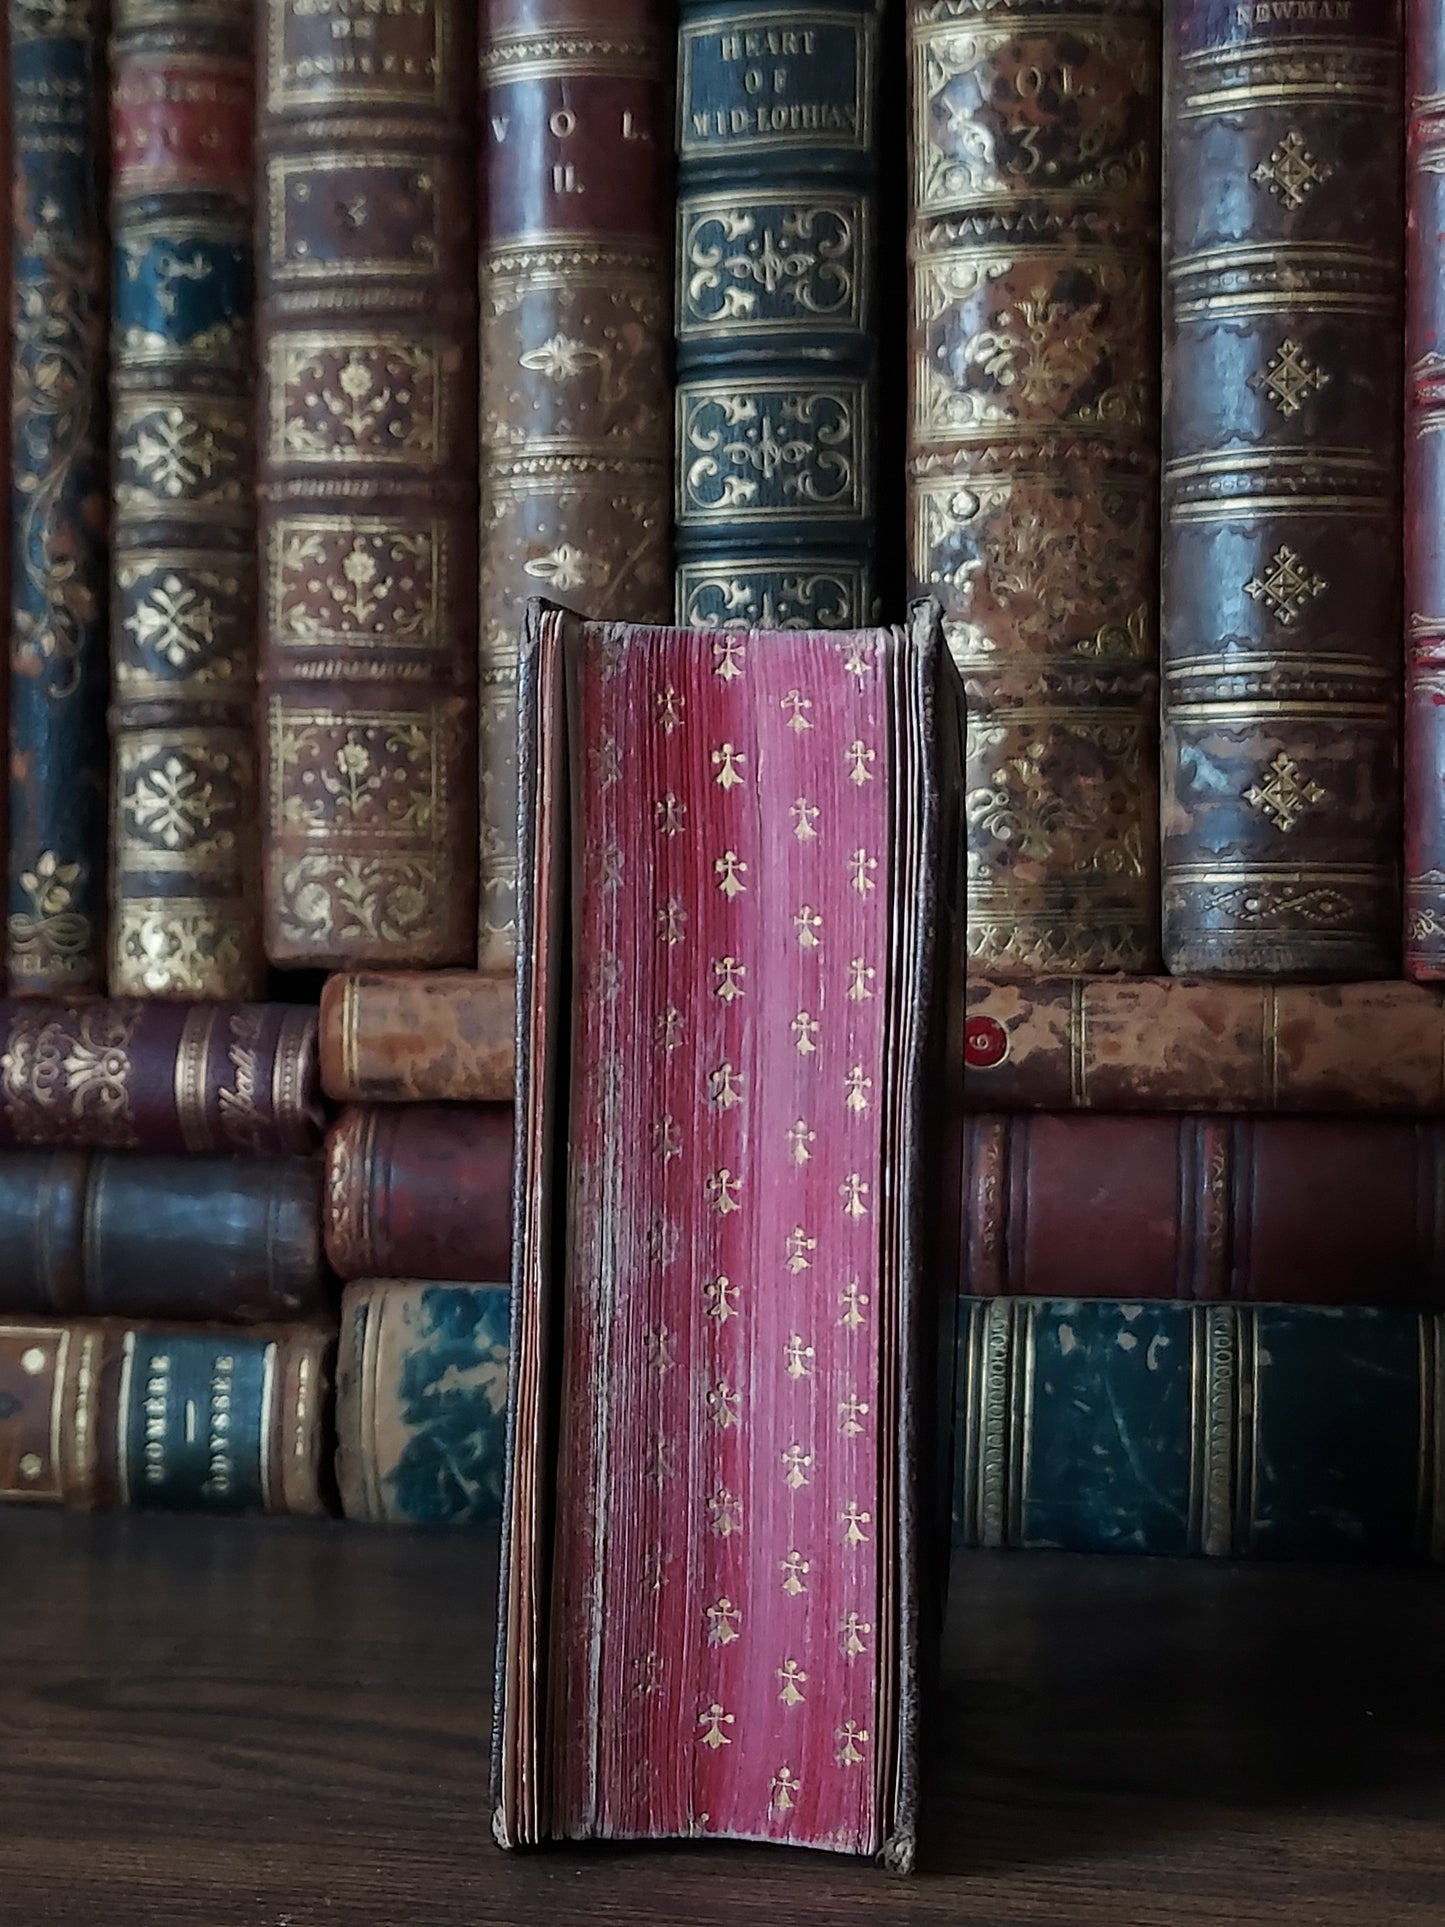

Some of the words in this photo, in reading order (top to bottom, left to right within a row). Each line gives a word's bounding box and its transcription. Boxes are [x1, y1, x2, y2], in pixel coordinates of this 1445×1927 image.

[1236, 2, 1349, 26] NEWMAN
[721, 30, 815, 62] HEART
[744, 67, 788, 95] OF
